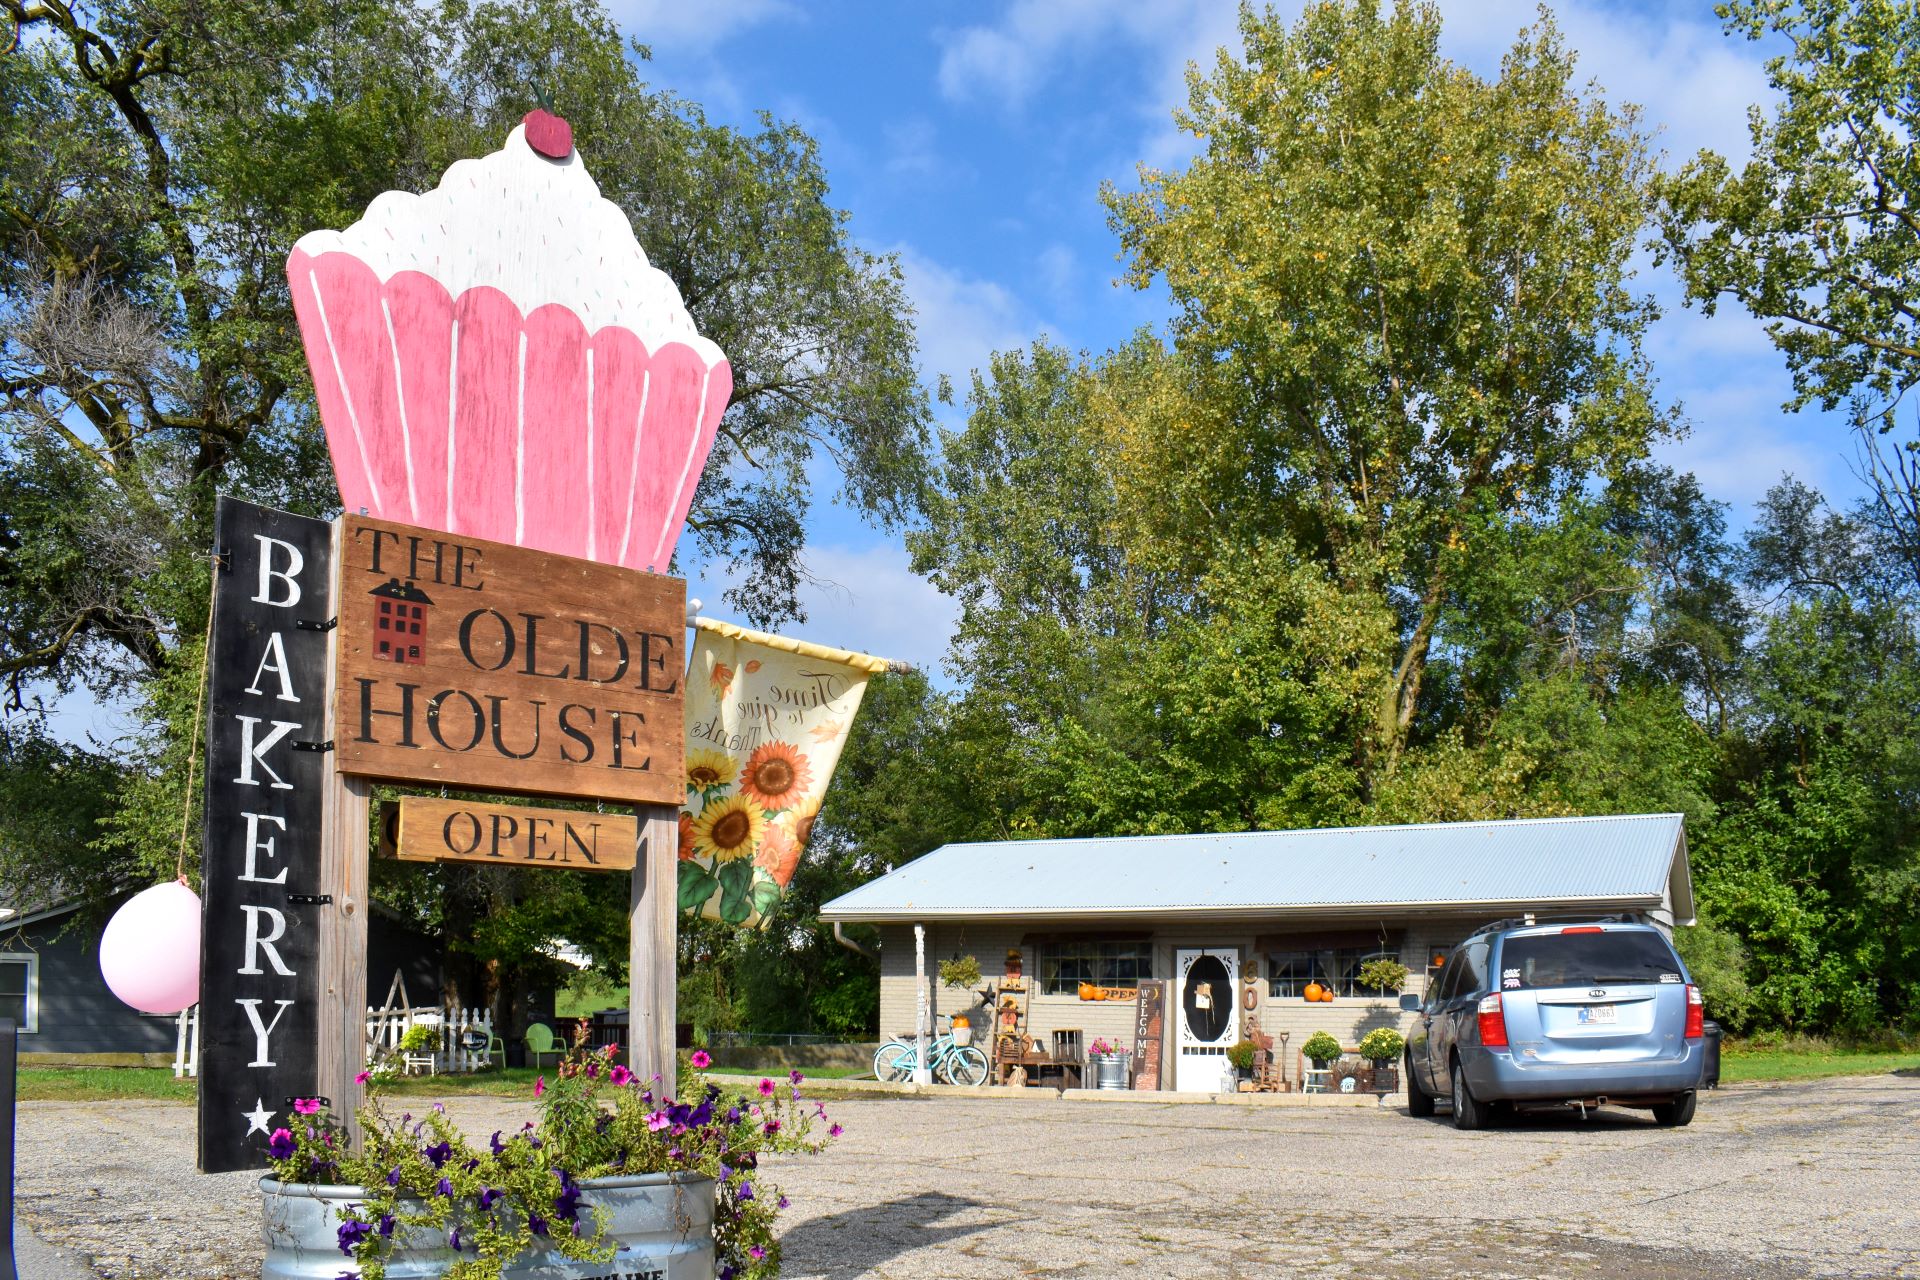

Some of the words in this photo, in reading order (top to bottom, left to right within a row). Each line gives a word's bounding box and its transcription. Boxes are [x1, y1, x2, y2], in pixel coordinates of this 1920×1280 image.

[355, 526, 484, 591] THE
[458, 608, 677, 694] OLDE
[353, 678, 651, 771] HOUSE
[233, 534, 304, 1068] BAKERY
[442, 811, 602, 865] OPEN
[1137, 988, 1150, 1059] WELCOME
